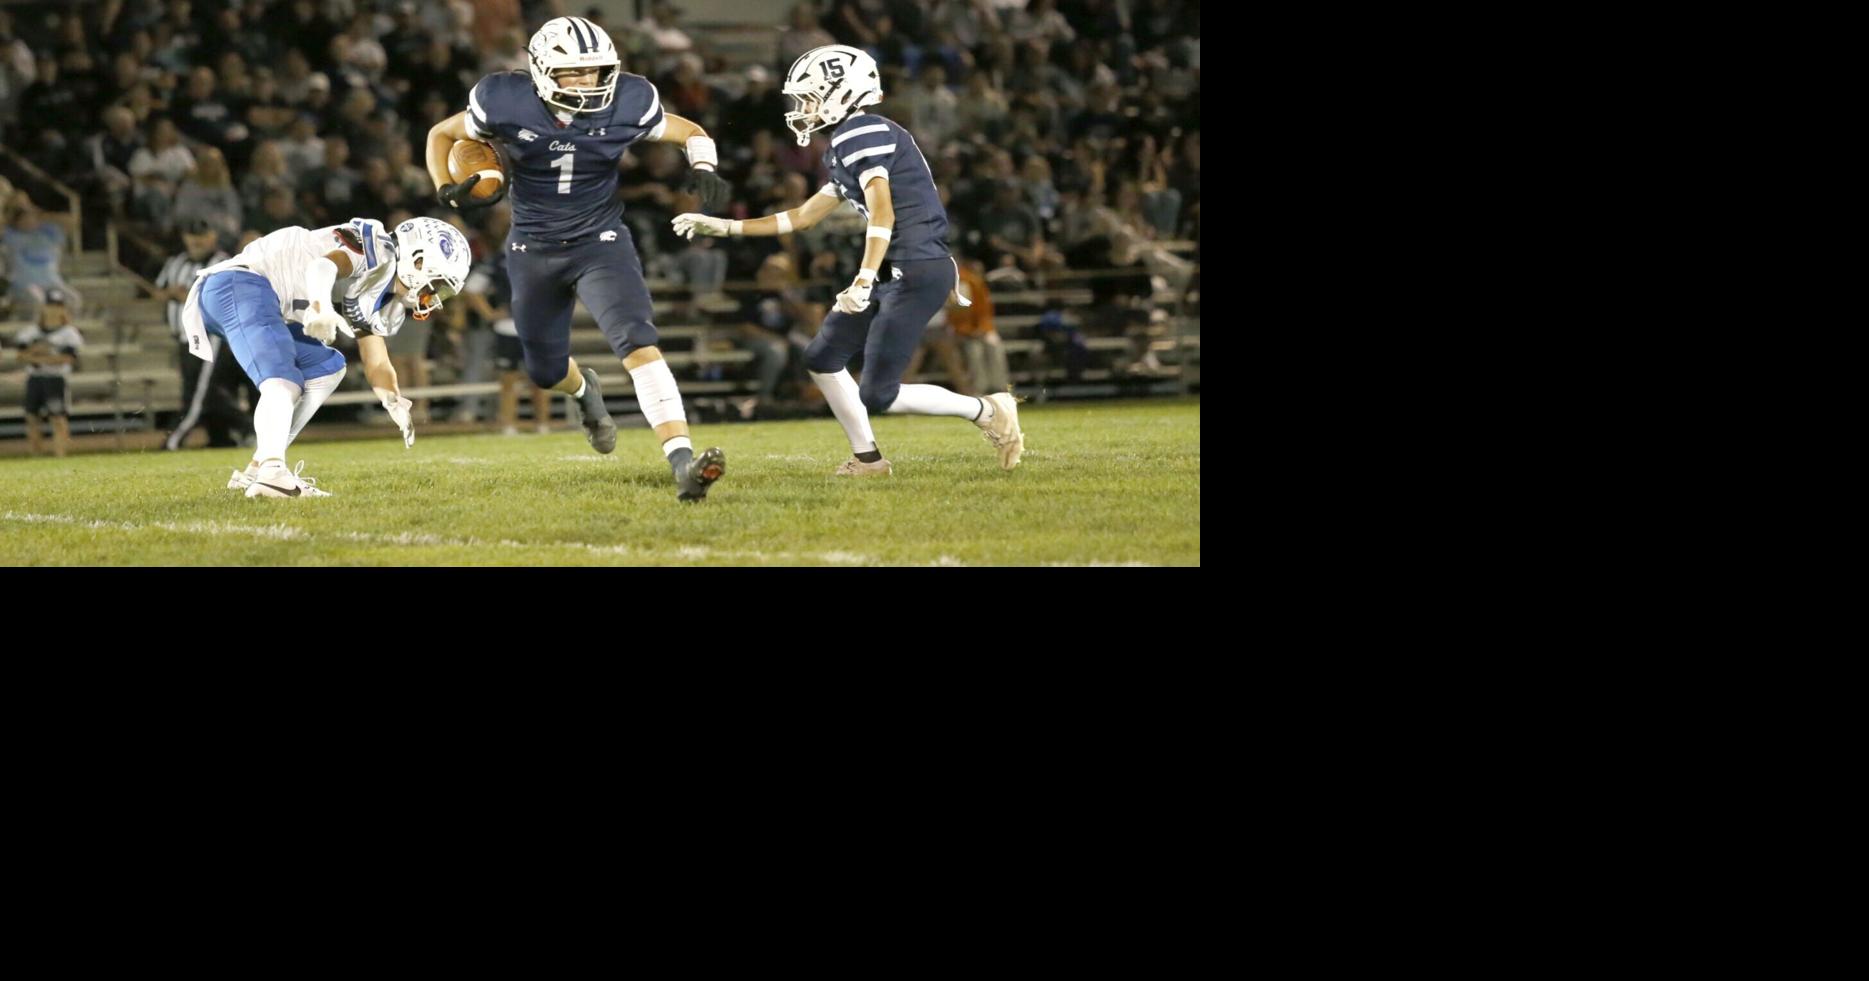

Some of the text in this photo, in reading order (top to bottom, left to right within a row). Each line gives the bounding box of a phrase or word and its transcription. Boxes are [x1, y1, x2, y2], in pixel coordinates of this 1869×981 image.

[819, 58, 845, 80] 15
[549, 140, 577, 151] Cats
[551, 153, 574, 194] 1
